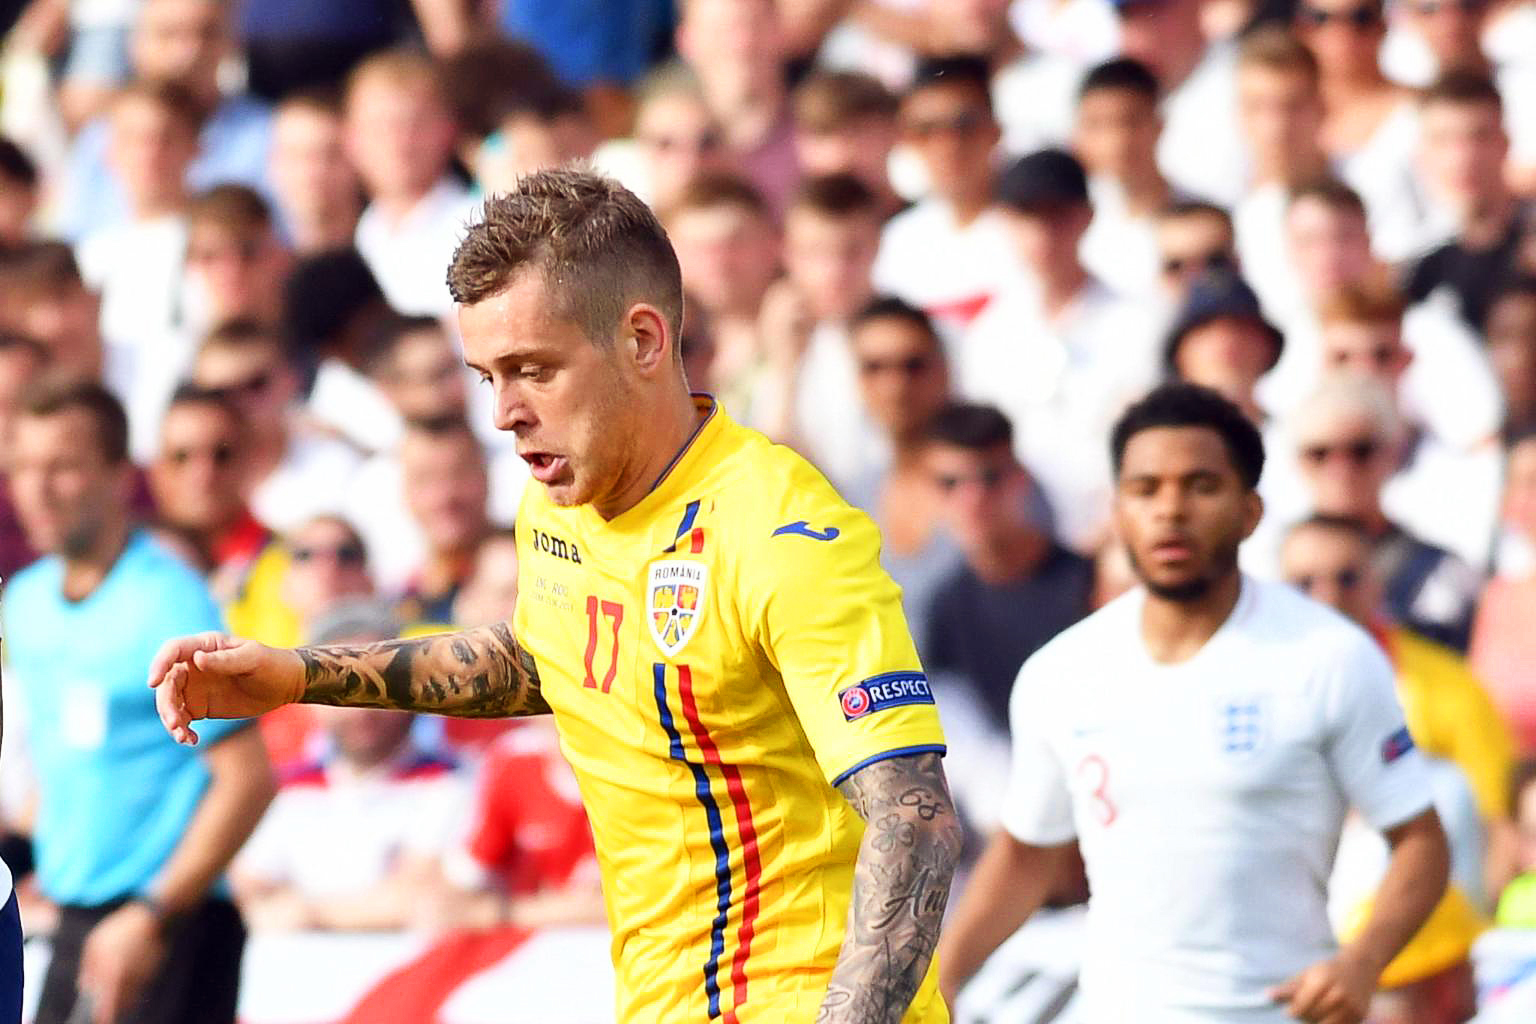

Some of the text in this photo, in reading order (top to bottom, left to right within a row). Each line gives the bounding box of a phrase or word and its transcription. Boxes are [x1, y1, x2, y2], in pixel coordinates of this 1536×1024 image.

[583, 595, 624, 694] 17
[869, 680, 930, 703] RESPECT
[1076, 752, 1119, 829] 3
